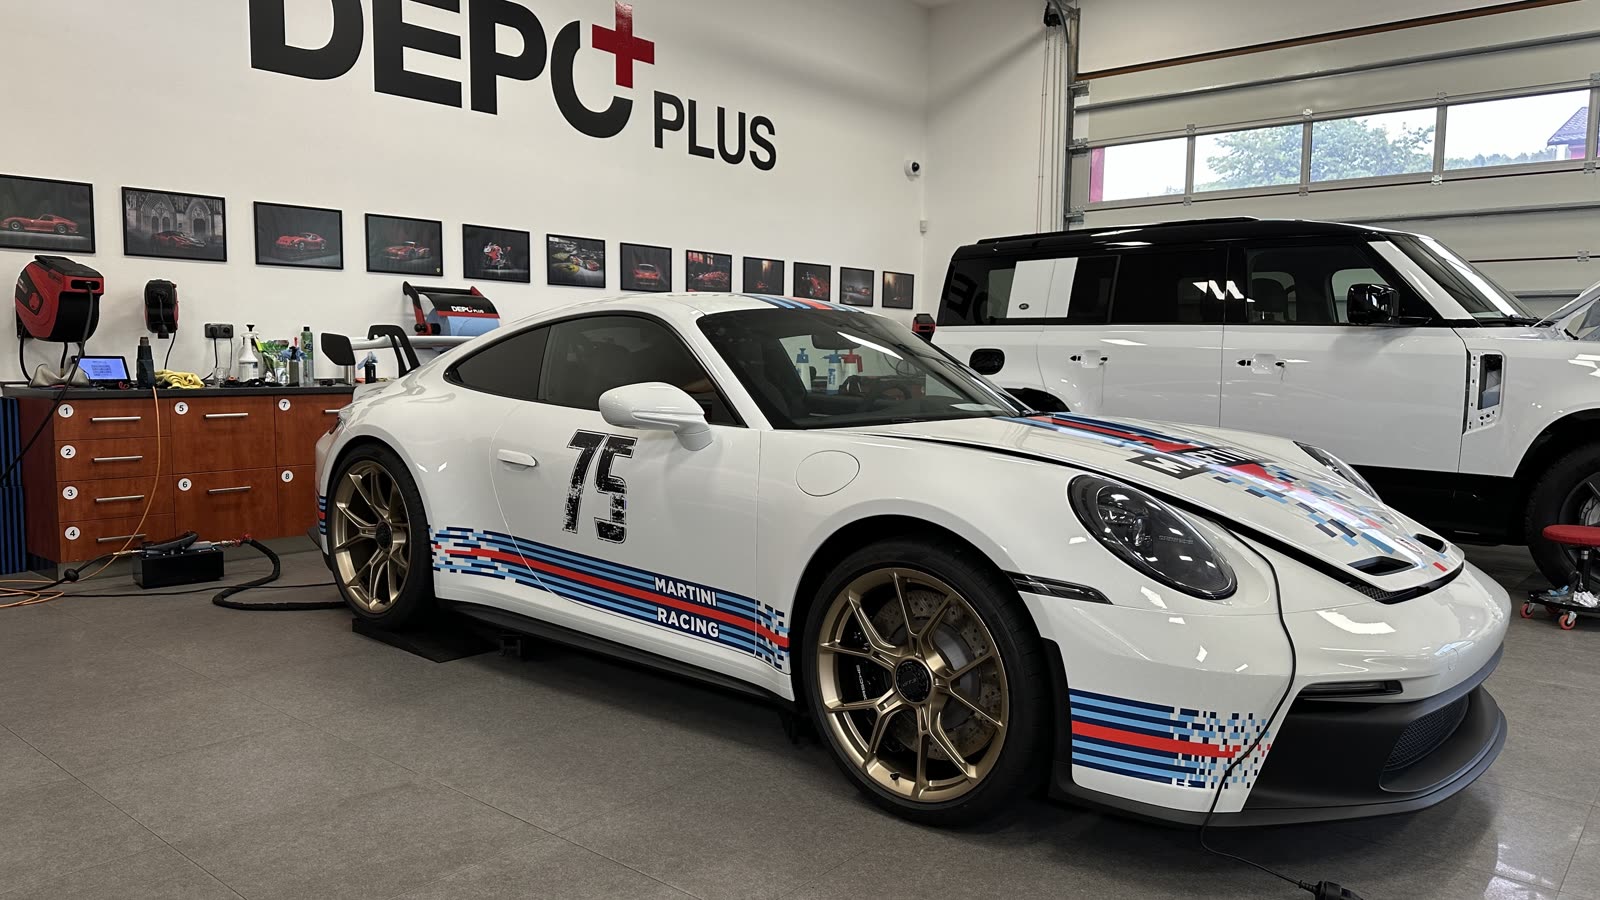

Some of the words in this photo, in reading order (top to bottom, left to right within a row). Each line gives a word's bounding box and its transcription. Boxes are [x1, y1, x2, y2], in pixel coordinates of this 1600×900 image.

[653, 90, 777, 171] PLUS
[178, 404, 185, 413] 5
[281, 401, 288, 409] 7
[63, 407, 69, 415] 1
[65, 448, 72, 457] 2
[284, 472, 291, 481] 8
[182, 480, 188, 489] 6
[562, 429, 638, 544] 75
[67, 488, 74, 498] 3
[69, 529, 76, 538] 4
[654, 577, 717, 607] MARTINI
[656, 607, 719, 638] RACING
